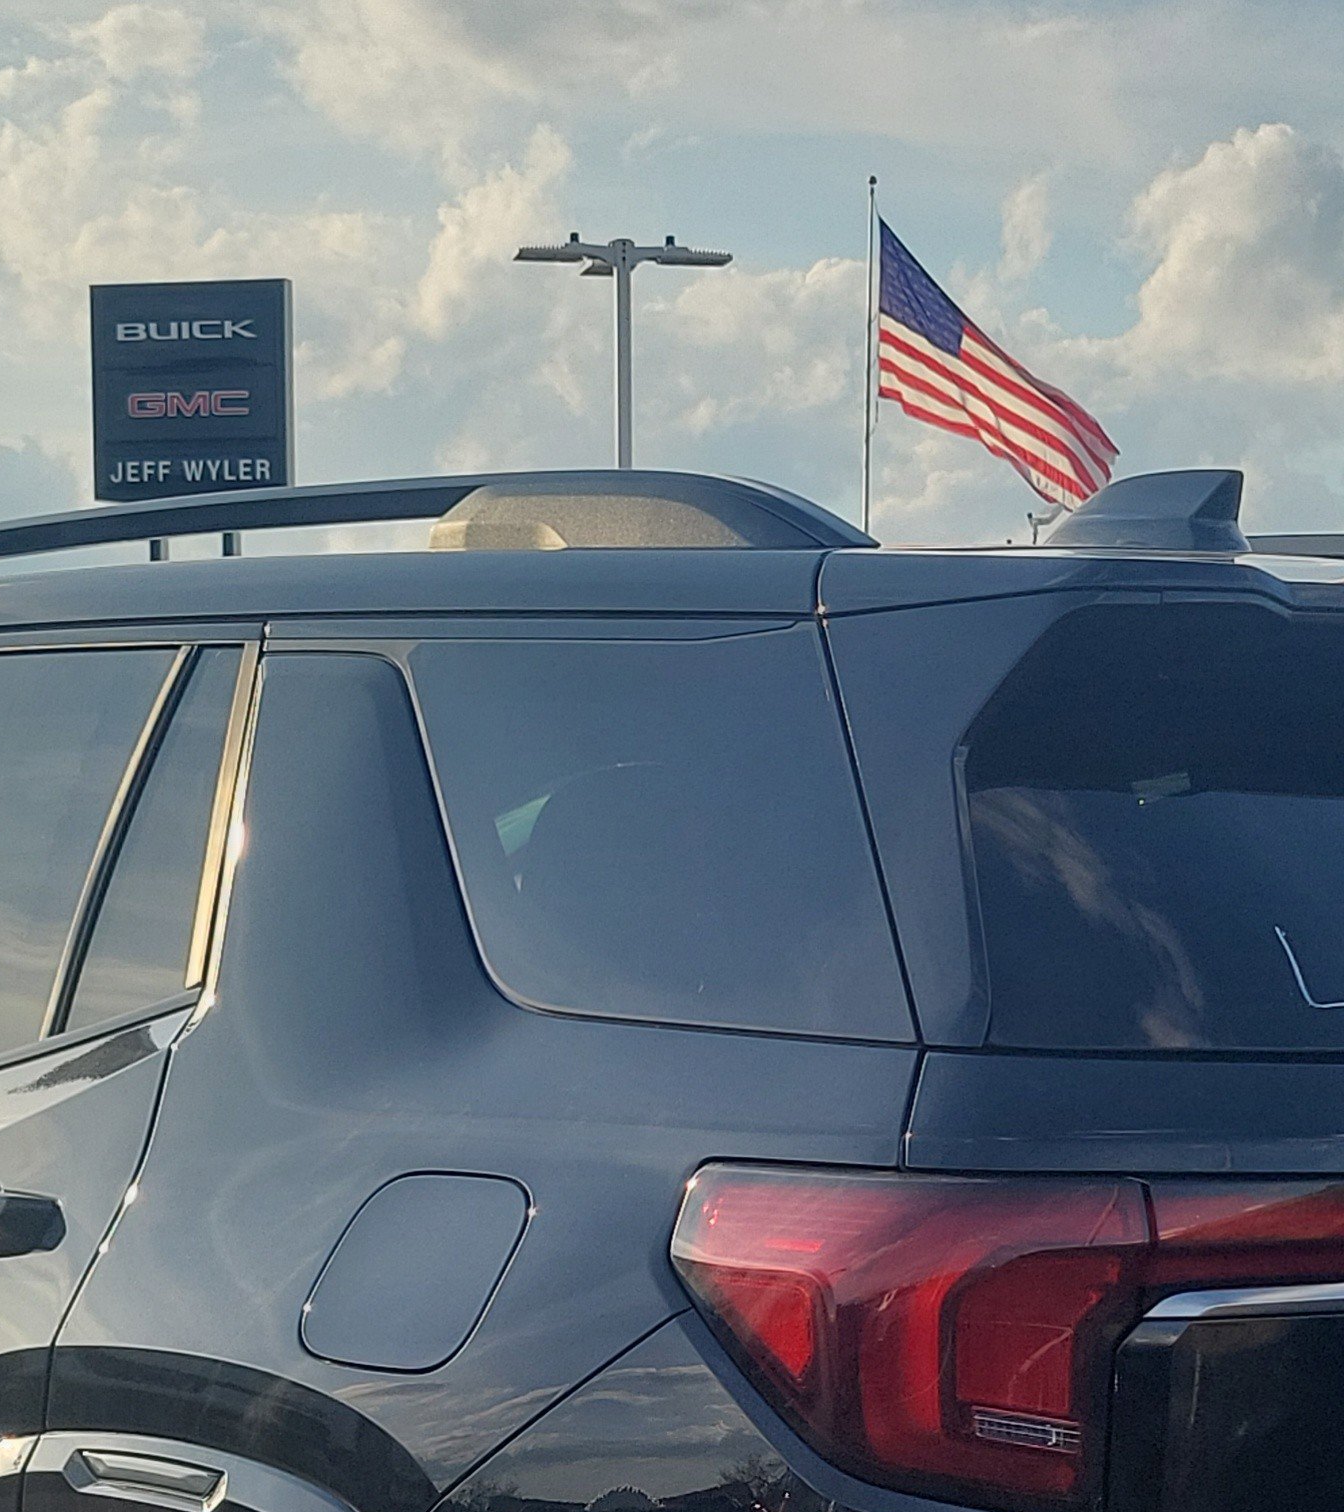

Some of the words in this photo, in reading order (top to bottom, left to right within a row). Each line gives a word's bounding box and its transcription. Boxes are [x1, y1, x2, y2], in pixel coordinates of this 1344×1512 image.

[116, 320, 257, 341] BUICK
[128, 390, 249, 418] GMC
[110, 460, 171, 483] JEFF
[183, 459, 271, 482] WYLER
